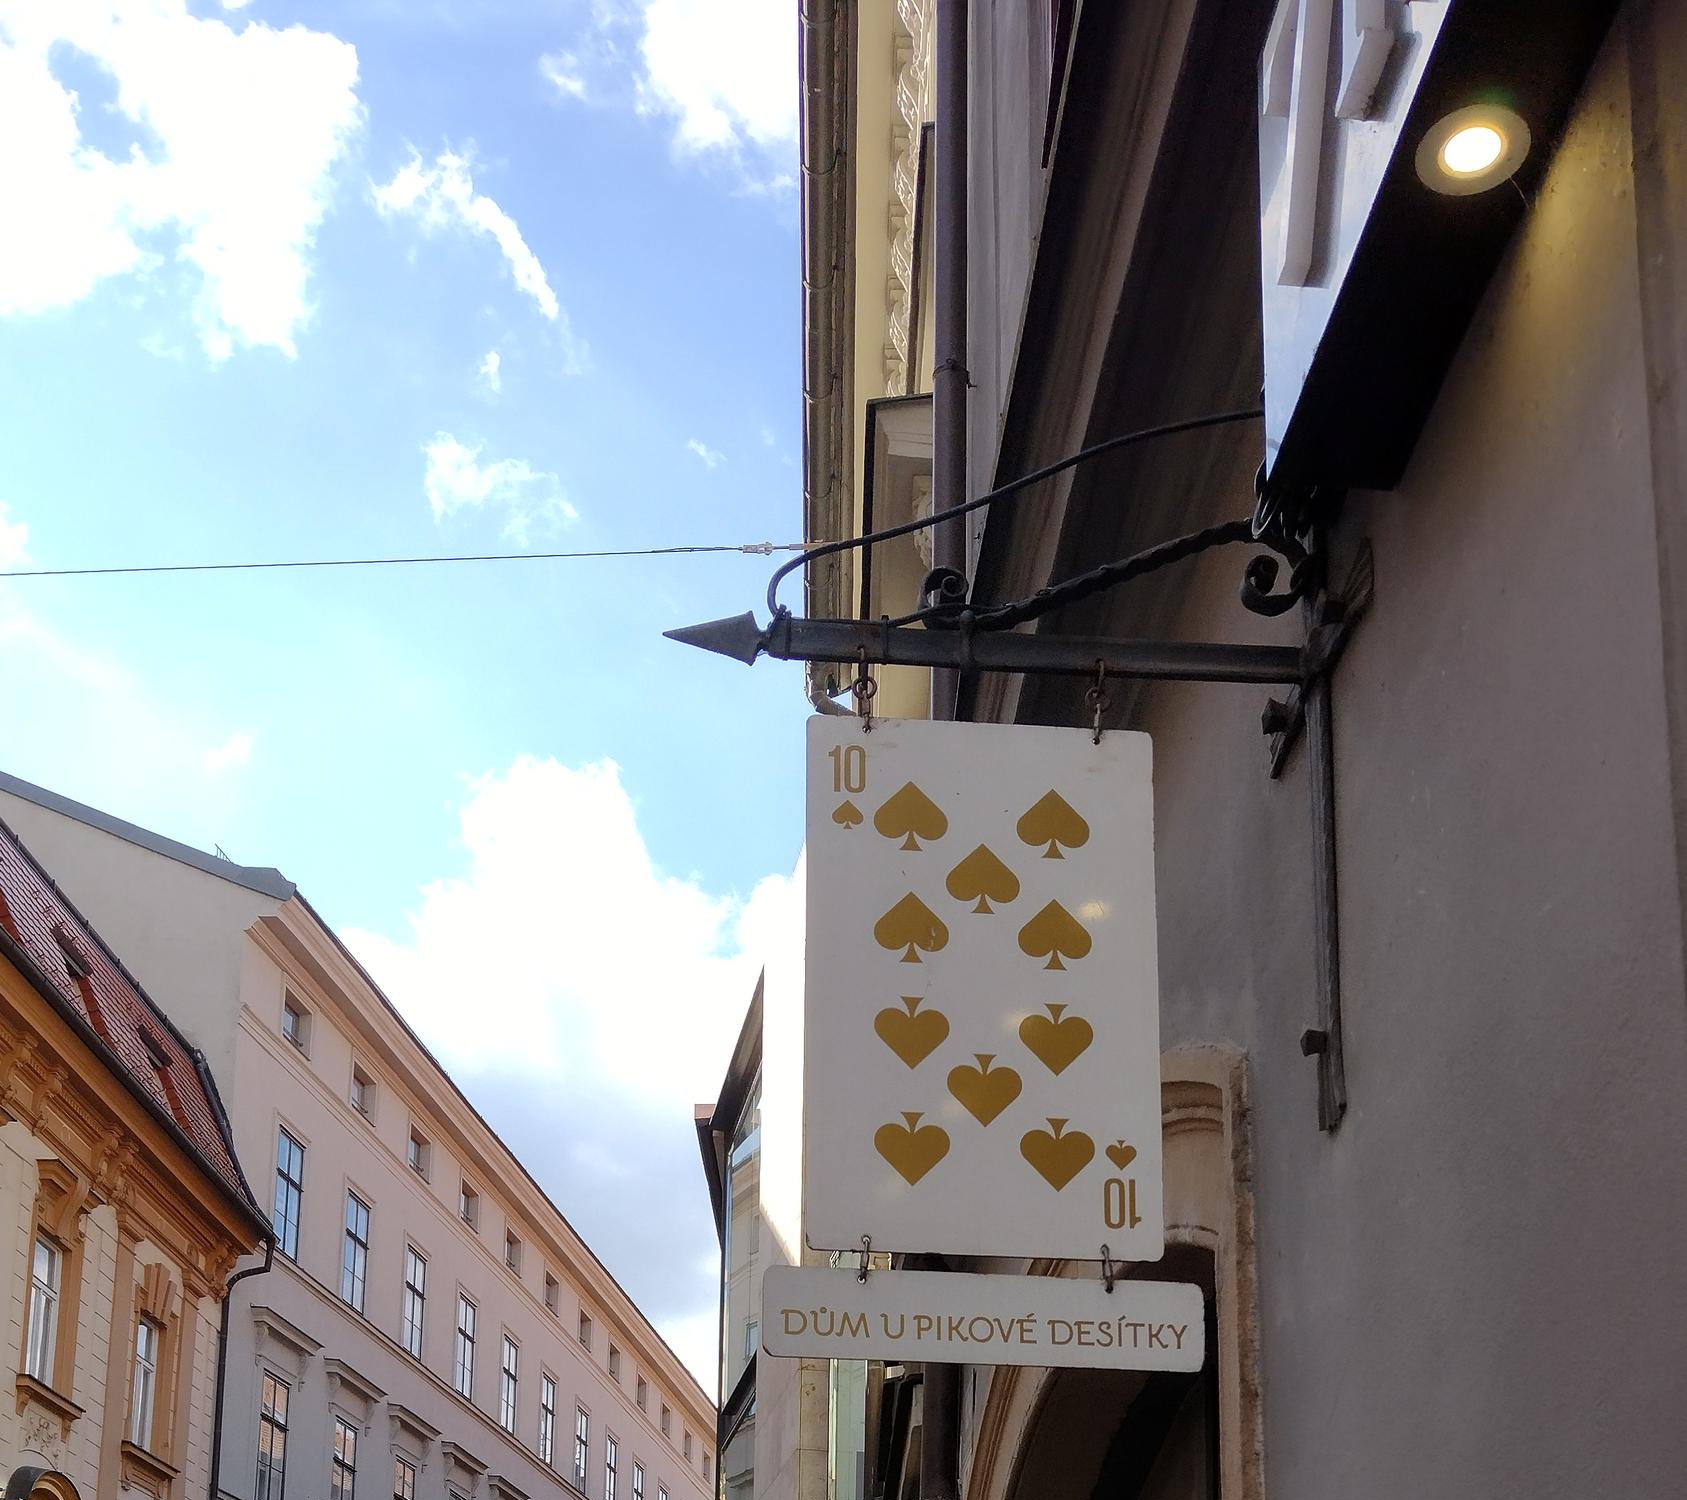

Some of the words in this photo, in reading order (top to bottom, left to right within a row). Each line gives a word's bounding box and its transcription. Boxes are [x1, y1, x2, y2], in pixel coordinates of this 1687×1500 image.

[827, 745, 866, 794] 10
[1103, 1178, 1142, 1230] 10
[780, 1306, 871, 1339] DŮM
[880, 1313, 905, 1340] U
[912, 1312, 1038, 1345] PIKOVÉ
[1046, 1314, 1189, 1350] DESÍTKY
